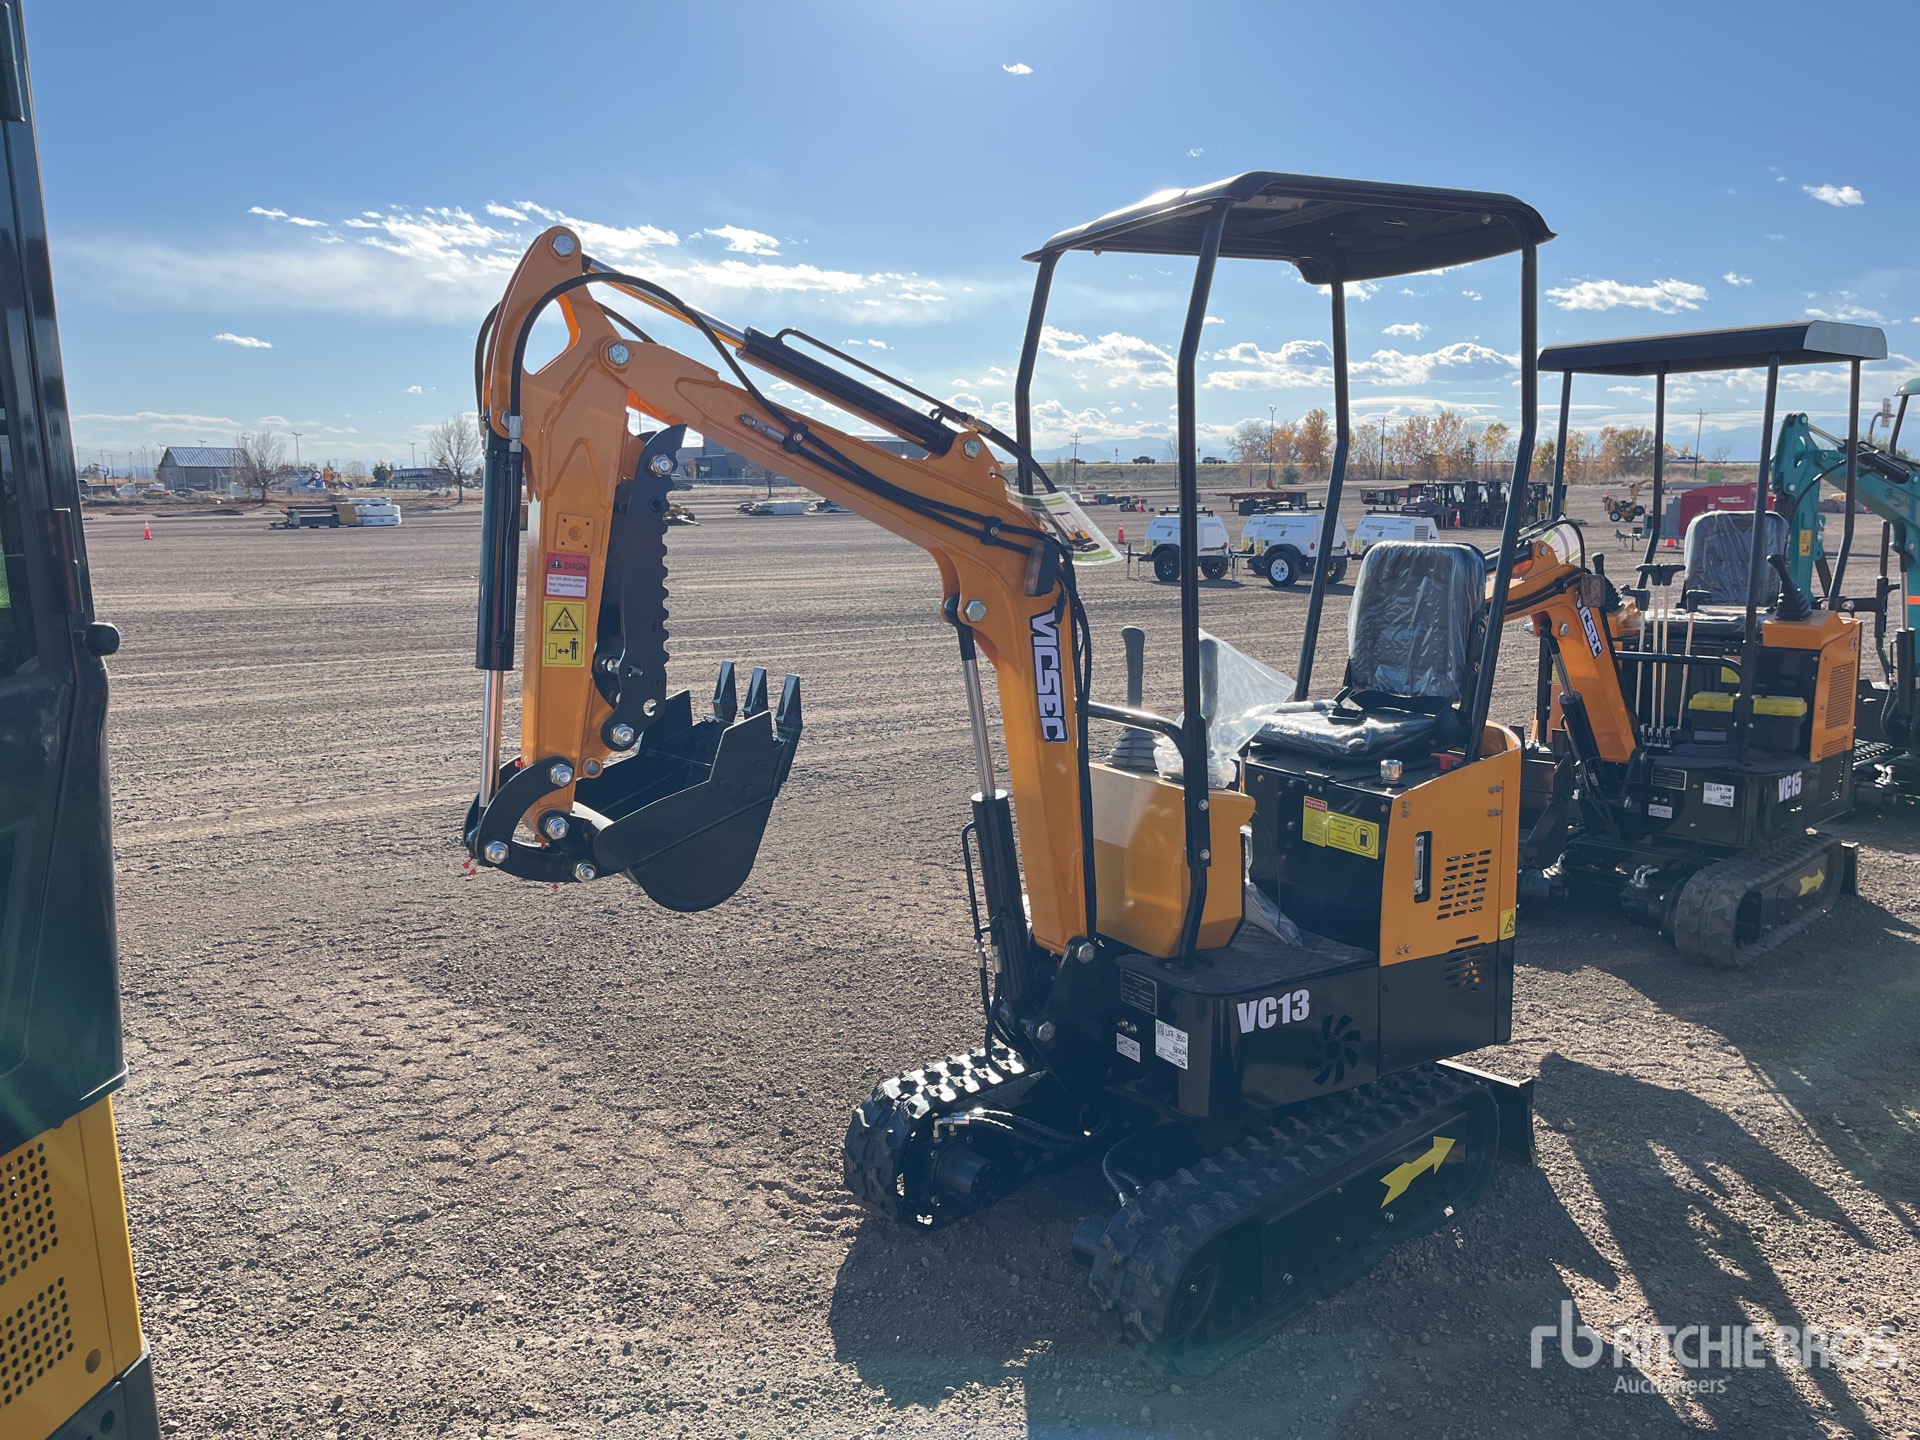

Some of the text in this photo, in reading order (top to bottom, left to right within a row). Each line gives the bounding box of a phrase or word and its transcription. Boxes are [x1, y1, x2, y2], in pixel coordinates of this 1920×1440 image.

[564, 561, 587, 571] DANGER
[1030, 607, 1067, 741] VICSEC
[1778, 770, 1802, 803] VC15
[1236, 988, 1311, 1034] VC13
